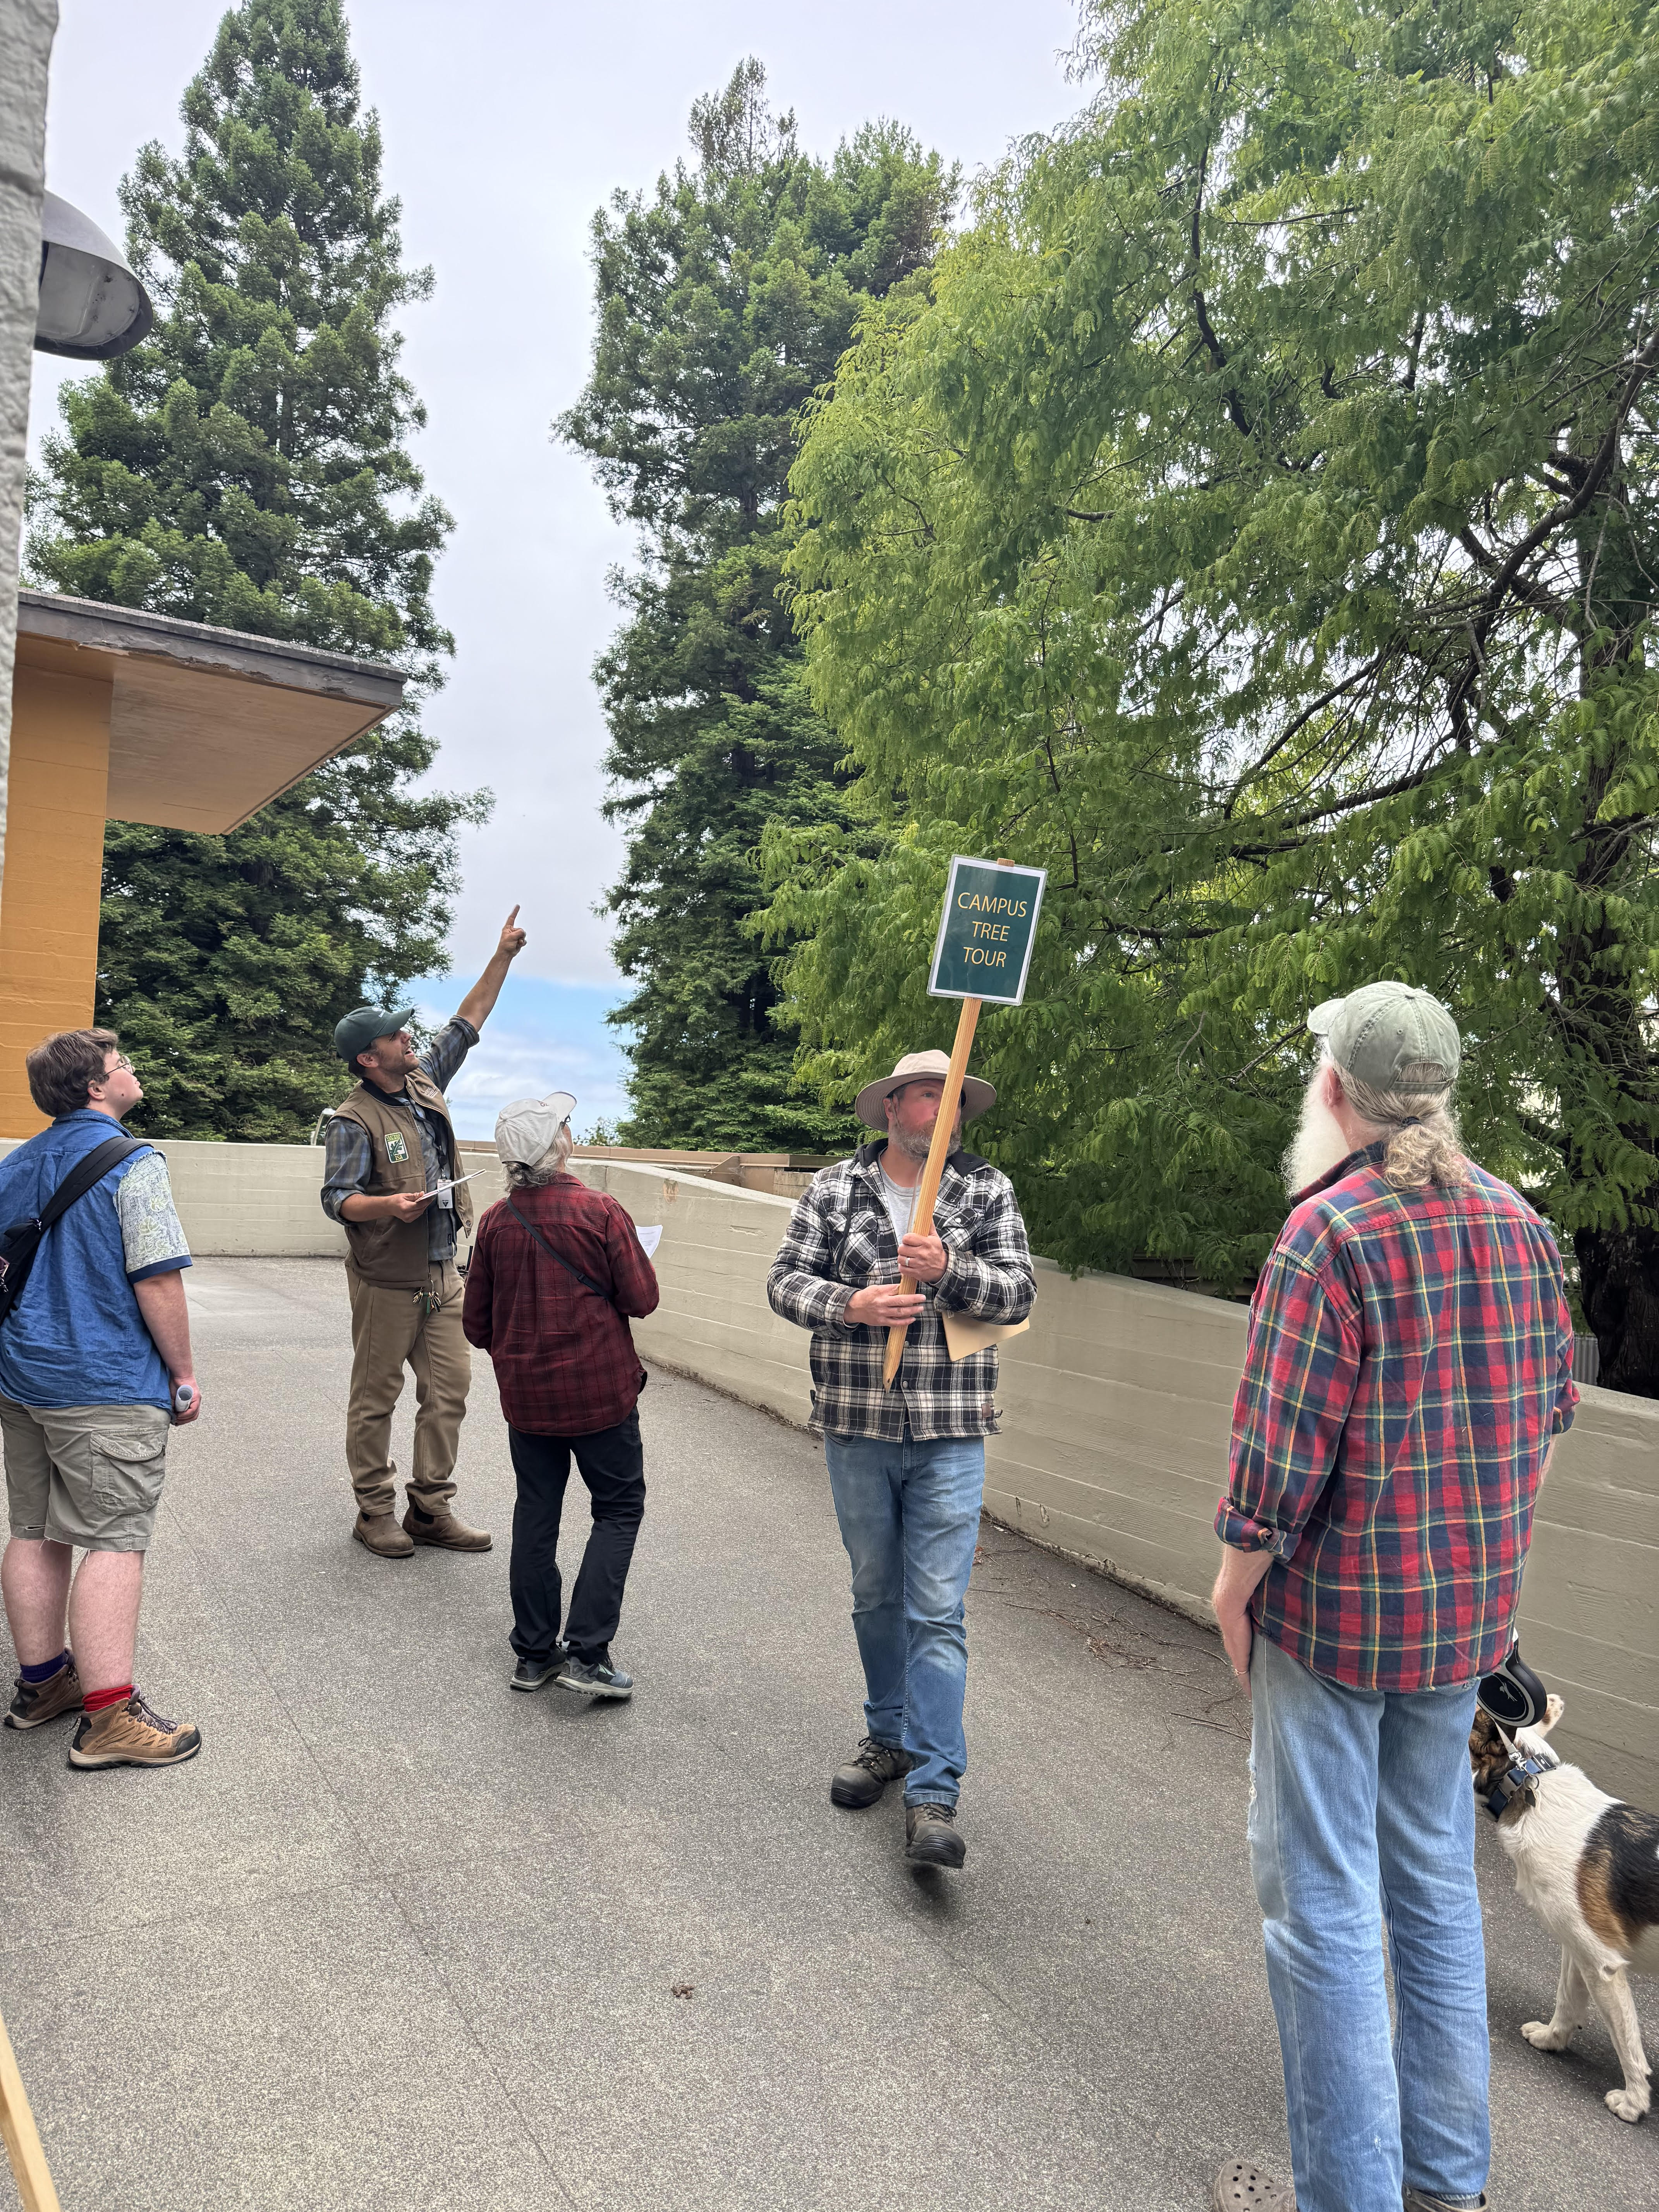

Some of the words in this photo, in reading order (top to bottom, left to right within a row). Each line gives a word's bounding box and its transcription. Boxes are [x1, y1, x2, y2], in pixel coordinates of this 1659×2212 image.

[958, 892, 1027, 917] CAMPUS
[972, 921, 1010, 941] TREE
[963, 947, 1006, 967] TOUR
